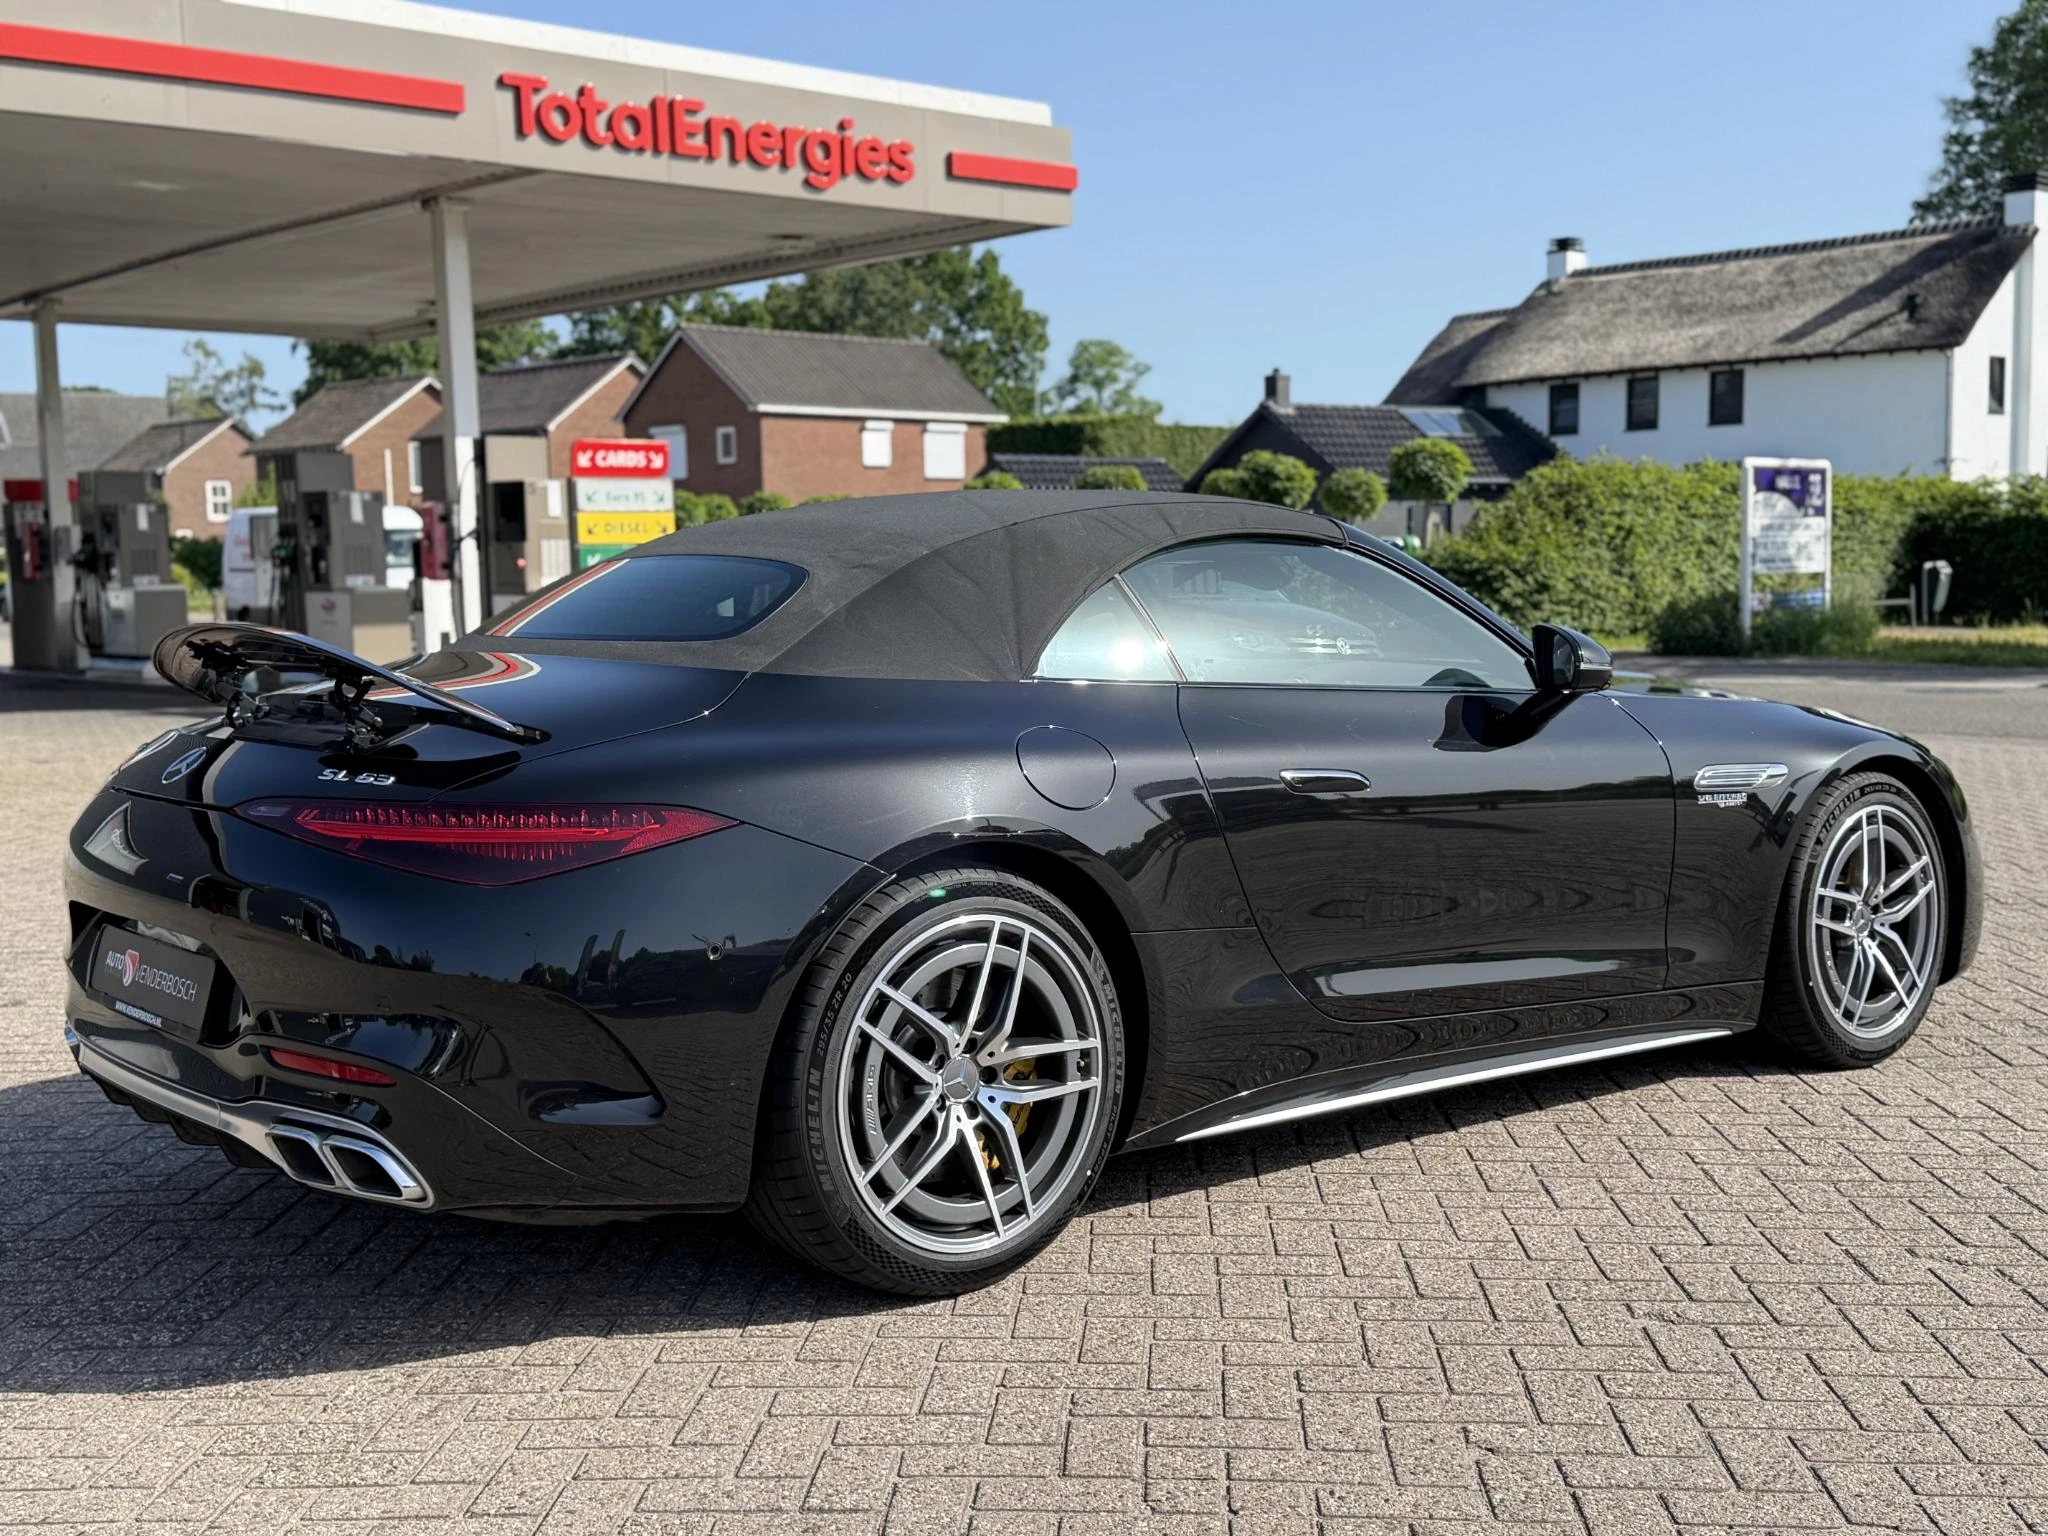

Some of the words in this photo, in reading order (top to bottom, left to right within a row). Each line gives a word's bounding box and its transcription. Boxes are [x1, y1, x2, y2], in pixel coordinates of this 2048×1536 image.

[500, 72, 915, 190] TotalEnergies
[595, 449, 648, 468] CARDS
[604, 523, 648, 534] DIESEL
[317, 769, 349, 781] SL
[354, 772, 395, 785] 63
[1818, 787, 1861, 843] MICHELIN
[105, 950, 125, 970] AUTO
[135, 964, 197, 1001] VENDERBOSCH
[817, 1009, 834, 1056] 295/35
[831, 990, 843, 1009] ZR
[841, 972, 852, 990] 20
[1104, 983, 1122, 1095] MICHELIN
[806, 1067, 835, 1191] MICHELIN
